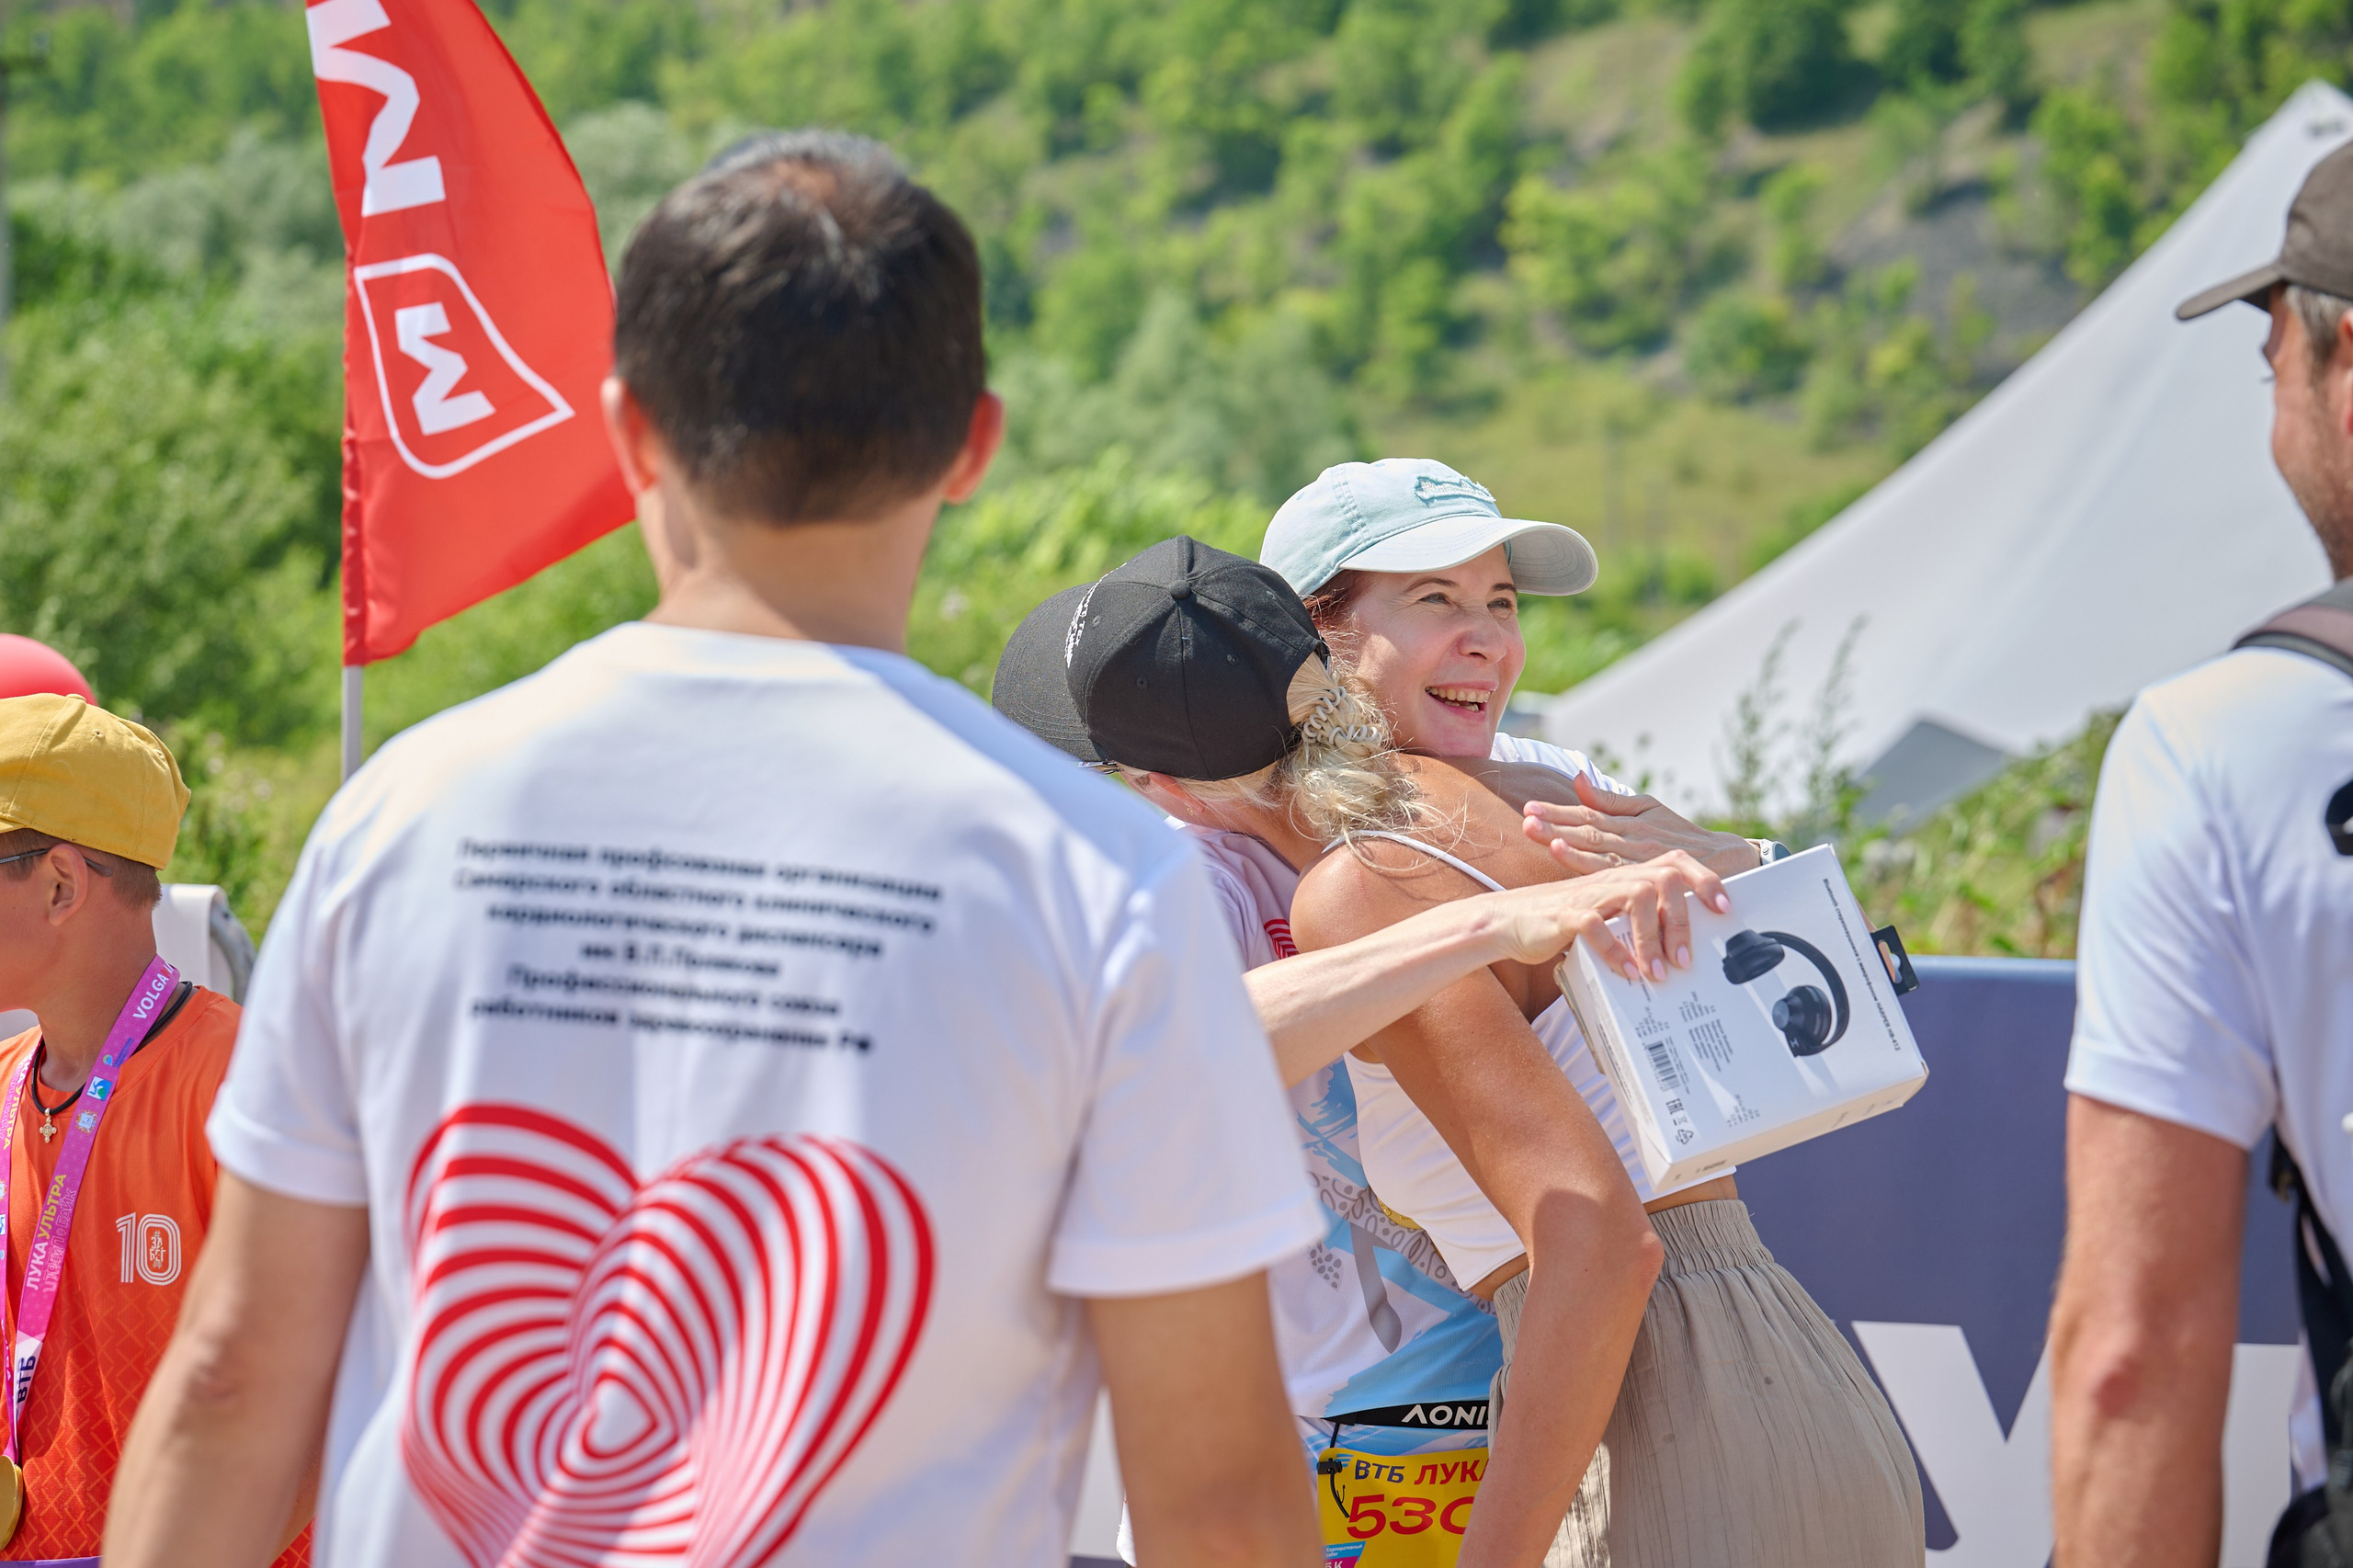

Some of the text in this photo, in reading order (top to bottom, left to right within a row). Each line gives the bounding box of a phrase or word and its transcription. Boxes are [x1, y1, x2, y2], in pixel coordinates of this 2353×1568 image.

[132, 973, 169, 1019] VOLGA
[1875, 1002, 1890, 1028] HARPER
[1886, 1028, 1900, 1051] HB-412
[56, 1187, 77, 1229] БАЙК
[27, 1174, 67, 1290] ЛУКА УЛЬТРА
[116, 1211, 182, 1286] 10
[17, 1355, 37, 1403] ВТБ
[1401, 1403, 1489, 1426] AONI
[1354, 1459, 1405, 1483] ВТБ
